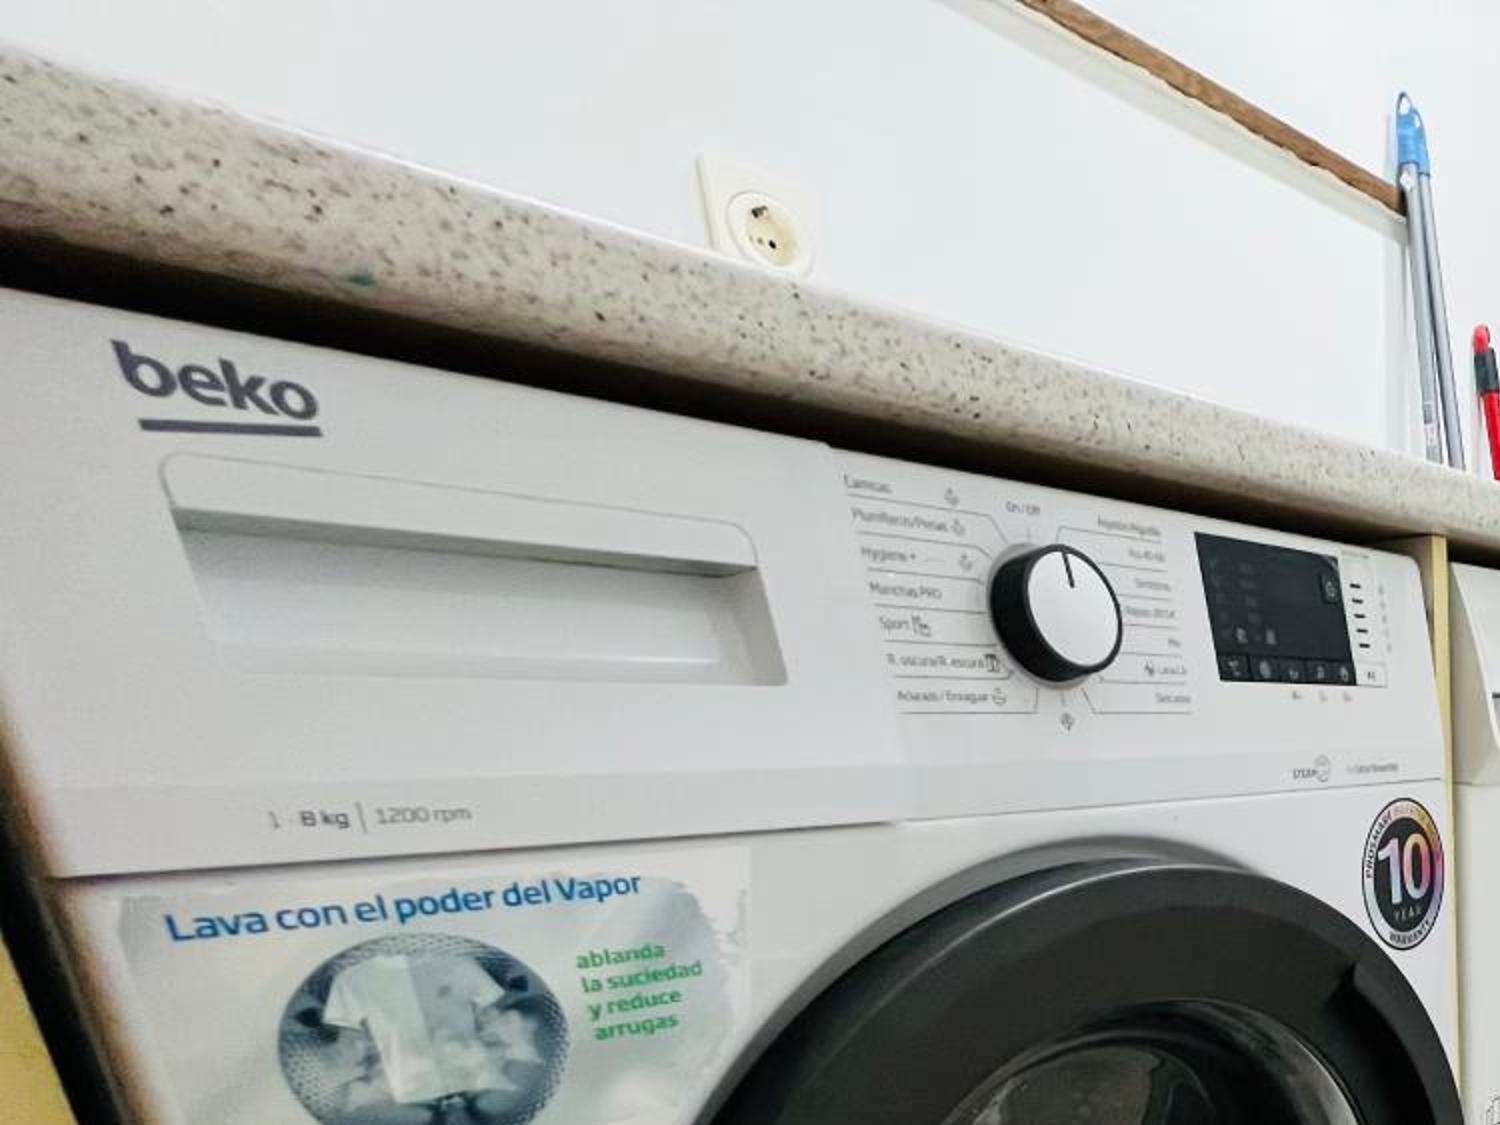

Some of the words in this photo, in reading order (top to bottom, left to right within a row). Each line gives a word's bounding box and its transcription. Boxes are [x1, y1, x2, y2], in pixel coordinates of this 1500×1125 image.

[110, 338, 319, 421] beko
[320, 810, 350, 829] kg
[375, 806, 431, 826] 1200
[432, 807, 474, 824] rpm
[1377, 833, 1431, 905] 10
[164, 911, 269, 943] Lava
[276, 900, 347, 931] con
[355, 894, 388, 923] el
[396, 885, 496, 925] poder
[503, 878, 551, 907] del
[554, 875, 641, 903] Vapor
[576, 943, 666, 969] ablanda
[581, 976, 603, 993] la
[607, 960, 703, 990] suciedad
[588, 1002, 602, 1021] y
[606, 990, 682, 1014] reduce
[594, 1014, 679, 1041] arrugas
